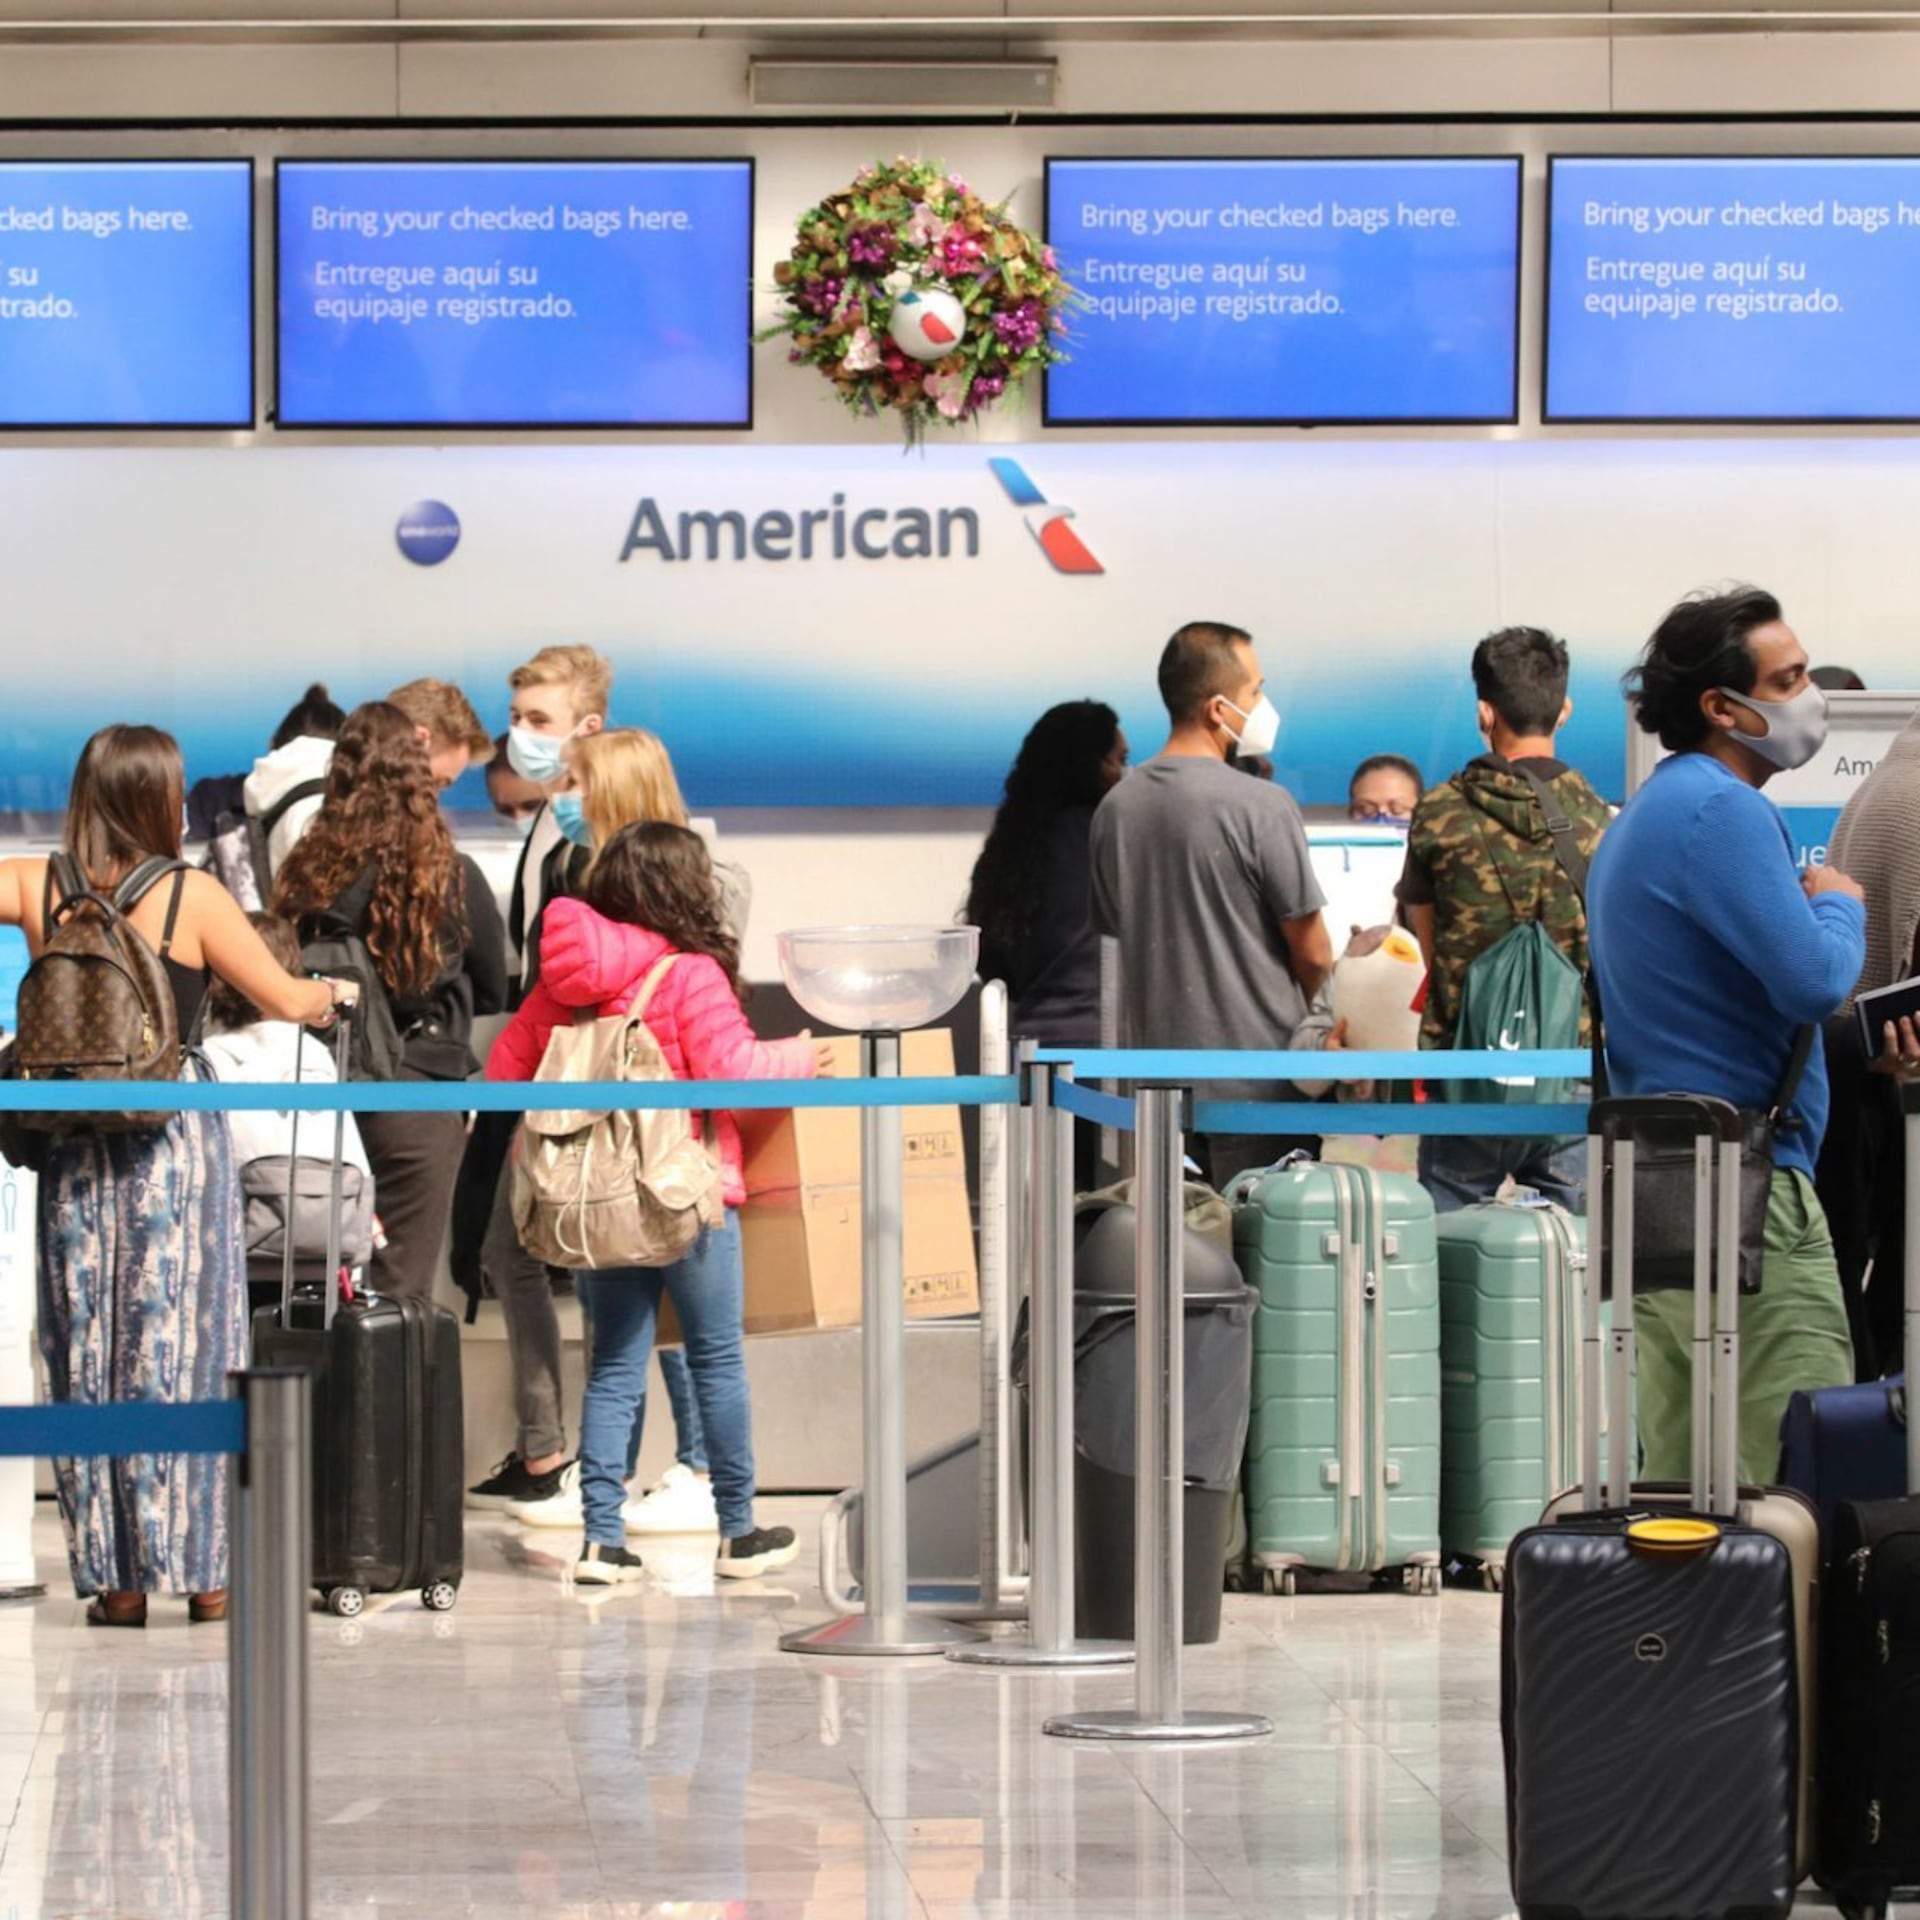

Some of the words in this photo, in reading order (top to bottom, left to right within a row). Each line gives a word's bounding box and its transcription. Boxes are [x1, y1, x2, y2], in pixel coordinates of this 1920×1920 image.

[61, 206, 122, 238] bags
[128, 206, 193, 230] here.
[311, 207, 378, 237] Bring
[383, 211, 443, 237] your
[449, 206, 554, 230] checked
[562, 206, 621, 237] bags
[628, 206, 692, 230] here.
[1081, 204, 1147, 234] Bring
[1152, 208, 1212, 234] your
[1218, 203, 1322, 227] checked
[1331, 202, 1389, 234] bags
[1397, 202, 1460, 227] here.
[1584, 203, 1649, 233] Bring
[1654, 206, 1714, 233] your
[1721, 201, 1824, 225] checked
[1832, 201, 1890, 232] bags
[8, 267, 38, 286] su
[315, 262, 435, 292] Entregue
[443, 260, 500, 290] aquí
[508, 266, 537, 285] su
[1084, 259, 1203, 289] Entregue
[1211, 257, 1269, 288] aquí
[1276, 264, 1305, 283] su
[1586, 257, 1704, 287] Entregue
[1713, 255, 1769, 286] aquí
[1777, 262, 1806, 281] su
[315, 294, 427, 324] equipaje
[437, 293, 576, 324] registrado.
[1085, 292, 1195, 320] equipaje
[1206, 291, 1344, 320] registrado.
[1585, 290, 1696, 319] equipaje
[1706, 289, 1843, 320] registrado.
[618, 492, 980, 563] American
